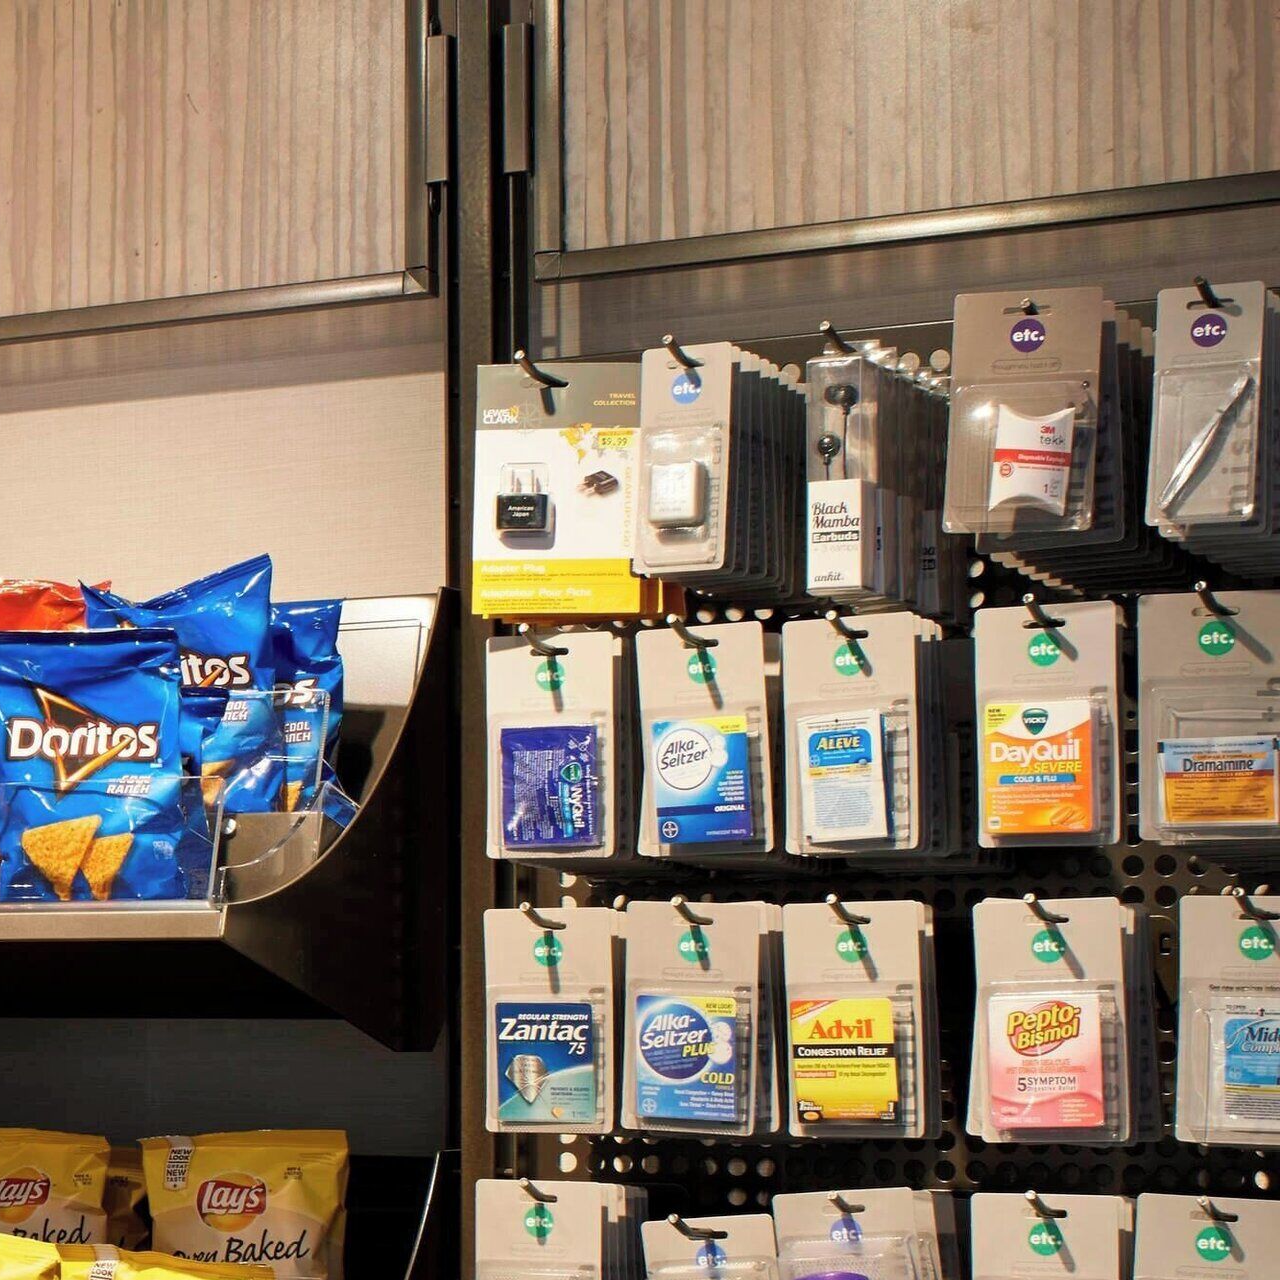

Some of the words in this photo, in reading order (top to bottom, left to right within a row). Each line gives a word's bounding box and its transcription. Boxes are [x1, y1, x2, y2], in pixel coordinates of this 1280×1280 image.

[1012, 329, 1045, 342] etc.
[1192, 325, 1226, 337] etc.
[1041, 425, 1056, 435] 3M
[812, 501, 848, 516] Black
[812, 515, 860, 529] Mamba
[812, 532, 859, 542] Earbuds
[1200, 632, 1235, 645] etc.
[1029, 643, 1061, 656] etc.
[1023, 716, 1047, 724] VICKS
[8, 719, 159, 758] Doritos
[816, 736, 860, 750] ALEVE
[666, 739, 699, 756] Alka-
[990, 738, 1081, 767] DayQuil
[661, 750, 708, 770] Seltzer
[1034, 760, 1082, 773] SEVERE
[1183, 757, 1254, 773] Dramamine
[1031, 941, 1065, 953] etc.
[1241, 936, 1275, 949] etc.
[517, 1013, 550, 1021] REGULAR
[646, 1014, 695, 1032] Alka-
[1007, 1004, 1081, 1035] Pepto-
[499, 1018, 588, 1041] Zantac
[808, 1019, 873, 1040] Advil
[1017, 1021, 1081, 1049] Bismol
[641, 1028, 708, 1050] Seltzer
[568, 1043, 586, 1055] 75
[797, 1046, 855, 1057] CONGESTION
[857, 1045, 888, 1057] RELIEF
[701, 1072, 734, 1084] COLD
[1028, 1076, 1076, 1086] SYMPTOM
[198, 1182, 265, 1215] Lay's
